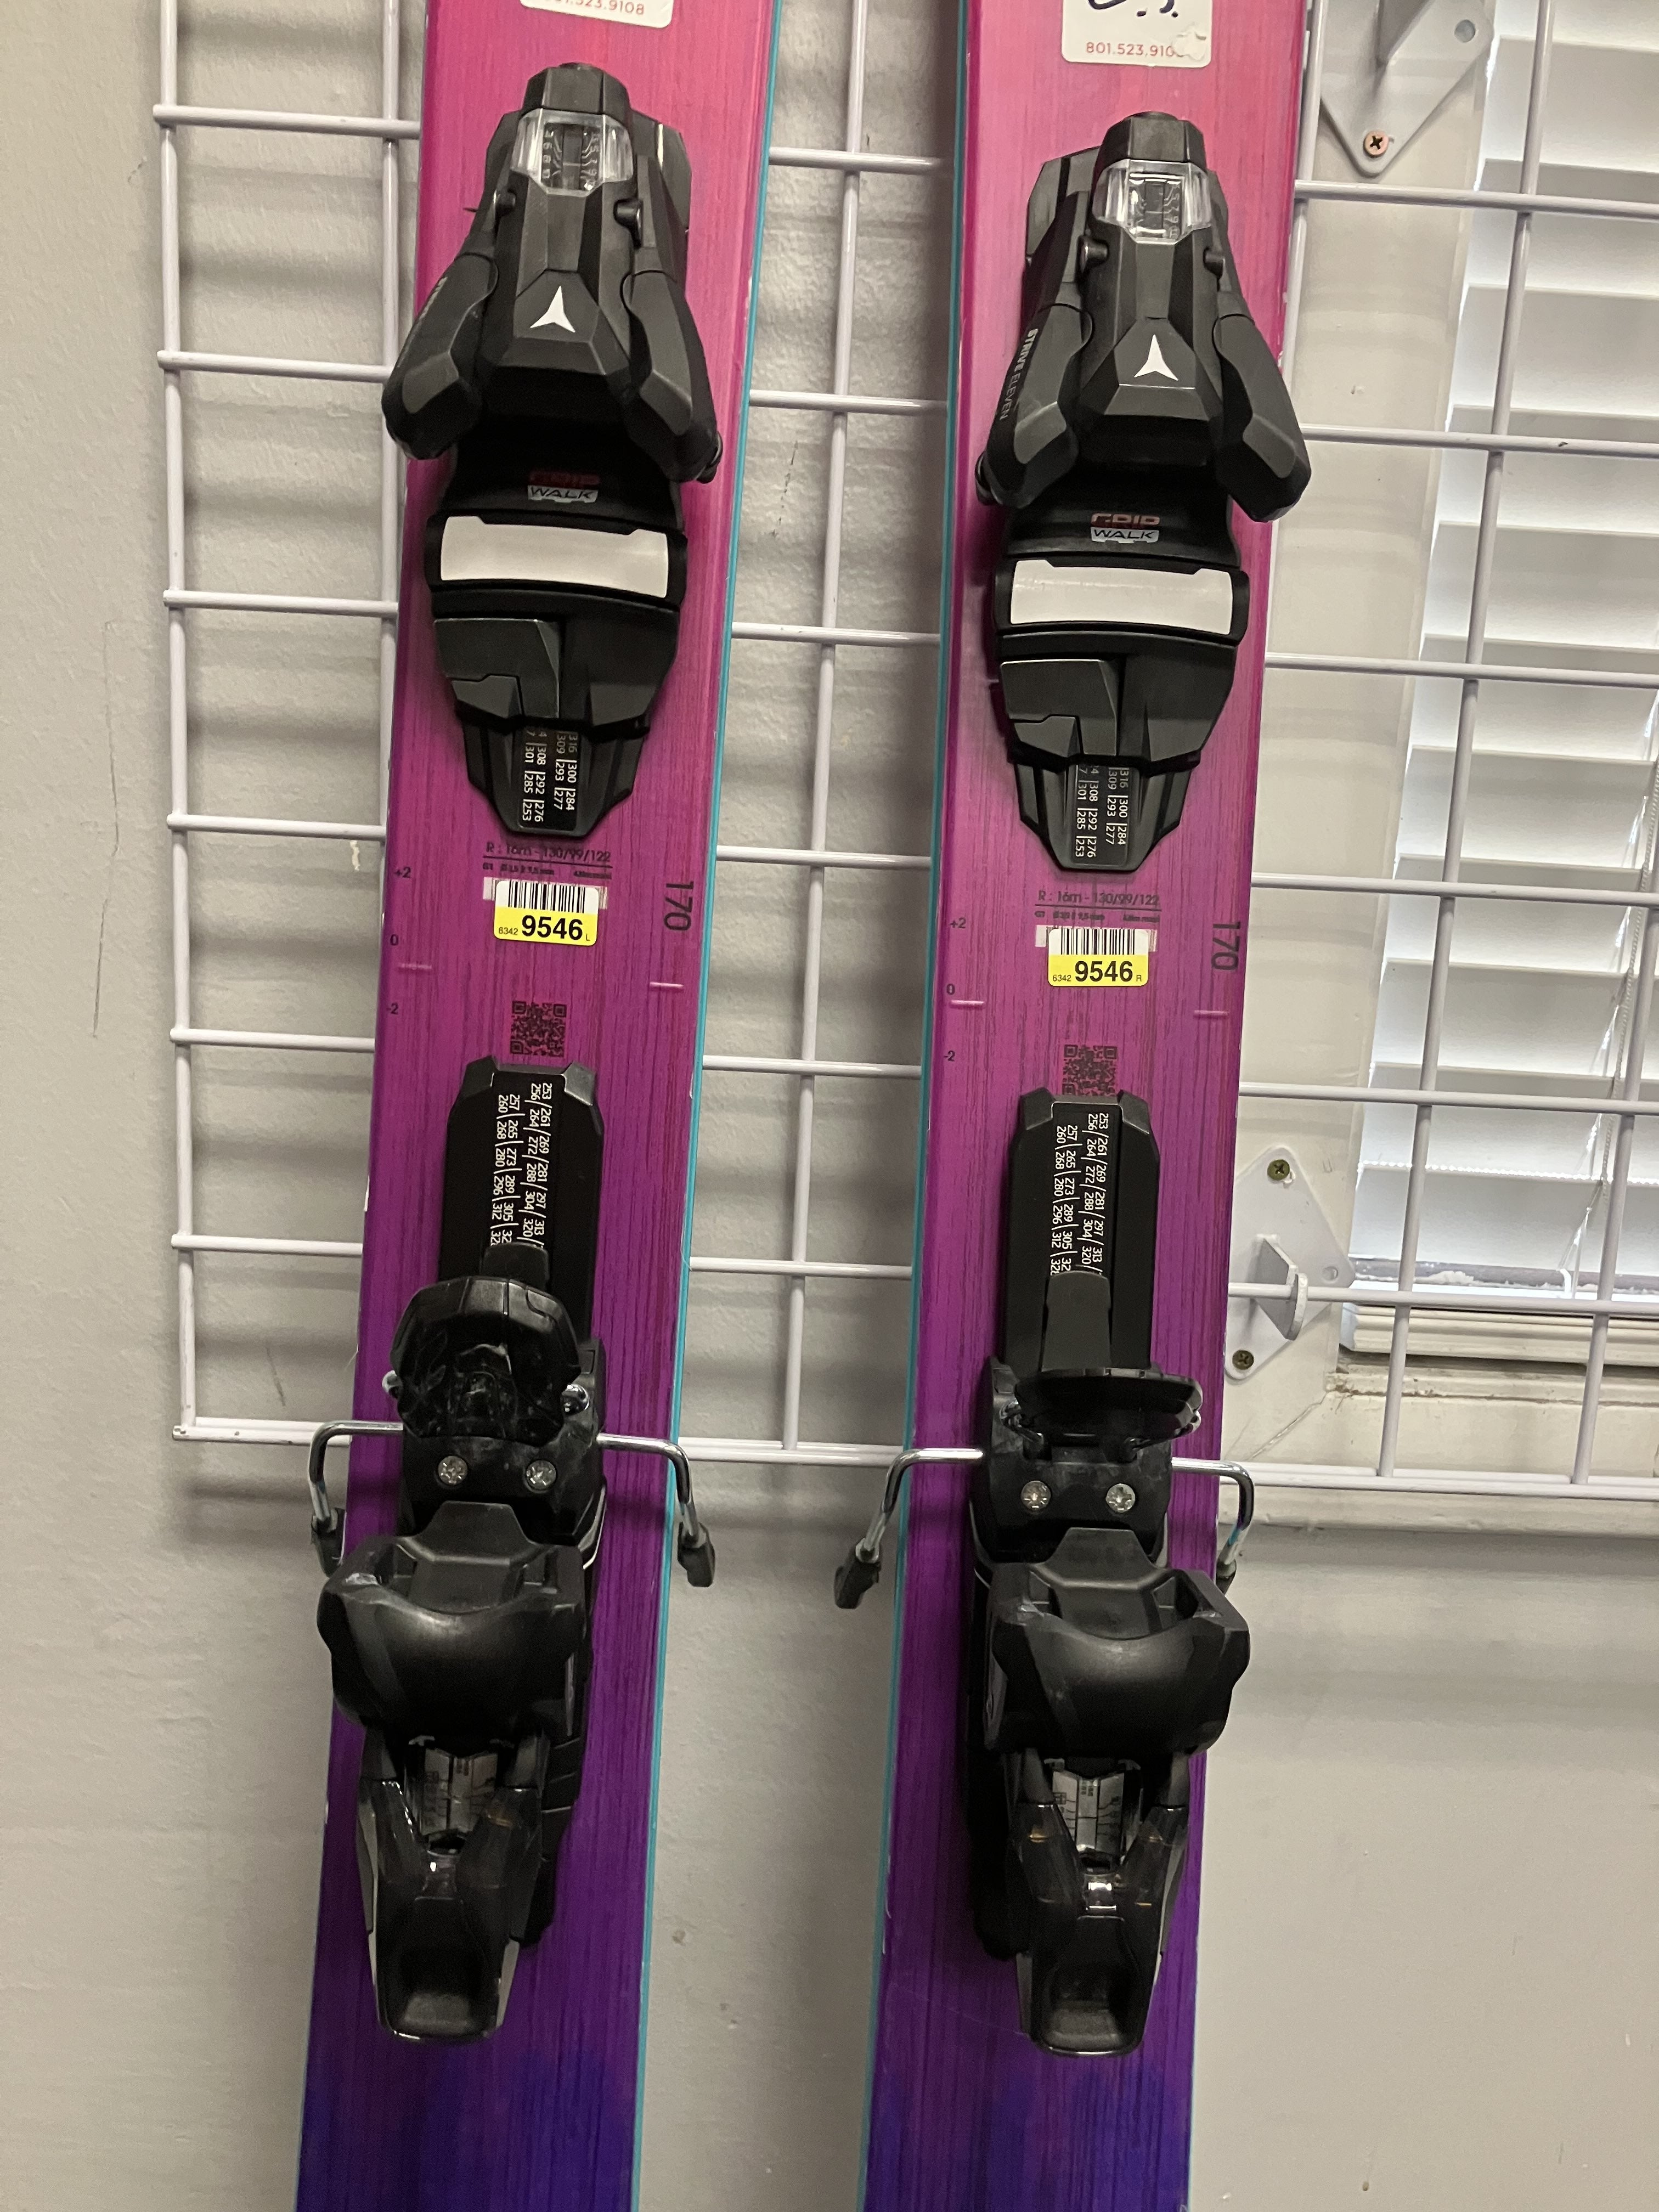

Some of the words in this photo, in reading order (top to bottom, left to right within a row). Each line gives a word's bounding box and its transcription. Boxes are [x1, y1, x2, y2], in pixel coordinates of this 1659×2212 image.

[1086, 42, 1184, 57] 801.523.910
[531, 487, 592, 498] WALK
[1094, 529, 1155, 539] WALK
[556, 734, 565, 754] 309
[569, 734, 578, 753] 316
[525, 746, 534, 763] 301
[537, 746, 546, 765] 308
[555, 763, 565, 781] 293
[567, 764, 577, 783] 300
[1108, 771, 1118, 790] 309
[1119, 770, 1129, 788] 316
[524, 774, 533, 793] 285
[535, 775, 545, 794] 292
[1077, 783, 1087, 800] 301
[1089, 783, 1098, 802] 308
[554, 790, 563, 810] 277
[566, 791, 575, 810] 284
[1107, 798, 1116, 817] 293
[1119, 799, 1128, 818] 300
[522, 803, 532, 821] 253
[534, 803, 544, 822] 276
[1076, 811, 1086, 830] 285
[1088, 812, 1098, 830] 292
[1105, 826, 1115, 845] 277
[1118, 826, 1127, 845] 284
[1075, 839, 1085, 857] 253
[1087, 839, 1097, 857] 276
[394, 867, 411, 878] +2
[664, 881, 693, 930] 170
[1039, 890, 1046, 901] R
[1057, 891, 1082, 902] 16m
[1093, 893, 1159, 905] 130/99/122
[498, 927, 518, 935] 6342
[522, 915, 583, 940] 9546
[950, 917, 966, 928] +2
[390, 934, 399, 946] 0
[1211, 922, 1240, 970] 170
[1075, 961, 1133, 982] 9546
[946, 984, 955, 995] 0
[944, 1051, 955, 1062] -2
[531, 1083, 541, 1100] 256
[542, 1083, 552, 1099] 253
[498, 1094, 508, 1113] 260
[509, 1094, 520, 1110] 257
[529, 1109, 540, 1127] 264
[541, 1109, 551, 1126] 261
[1088, 1114, 1097, 1131] 256
[1099, 1113, 1109, 1129] 253
[496, 1121, 506, 1139] 268
[508, 1120, 518, 1138] 265
[1057, 1126, 1066, 1143] 260
[1068, 1125, 1077, 1141] 257
[528, 1136, 538, 1154] 272
[539, 1136, 550, 1153] 269
[1086, 1139, 1097, 1156] 264
[1097, 1138, 1108, 1155] 261
[495, 1148, 505, 1167] 280
[506, 1148, 517, 1166] 273
[1056, 1152, 1065, 1170] 268
[1066, 1150, 1076, 1168] 265
[527, 1163, 537, 1182] 288
[538, 1163, 548, 1182] 281
[1085, 1166, 1095, 1183] 272
[1097, 1165, 1107, 1182] 269
[494, 1176, 504, 1195] 296
[505, 1175, 515, 1194] 289
[1054, 1178, 1064, 1197] 280
[1065, 1178, 1075, 1195] 273
[524, 1191, 535, 1210] 304
[536, 1193, 546, 1209] 297
[1085, 1192, 1094, 1210] 288
[1095, 1192, 1105, 1210] 281
[492, 1204, 502, 1220] 312
[503, 1203, 514, 1221] 305
[1052, 1206, 1063, 1224] 296
[1064, 1204, 1074, 1222] 289
[523, 1218, 533, 1237] 320
[534, 1219, 545, 1235] 313
[1083, 1219, 1093, 1238] 304
[1094, 1221, 1104, 1236] 297
[1051, 1232, 1062, 1248] 312
[1062, 1231, 1072, 1249] 305
[1082, 1246, 1092, 1265] 320
[1093, 1248, 1102, 1262] 313
